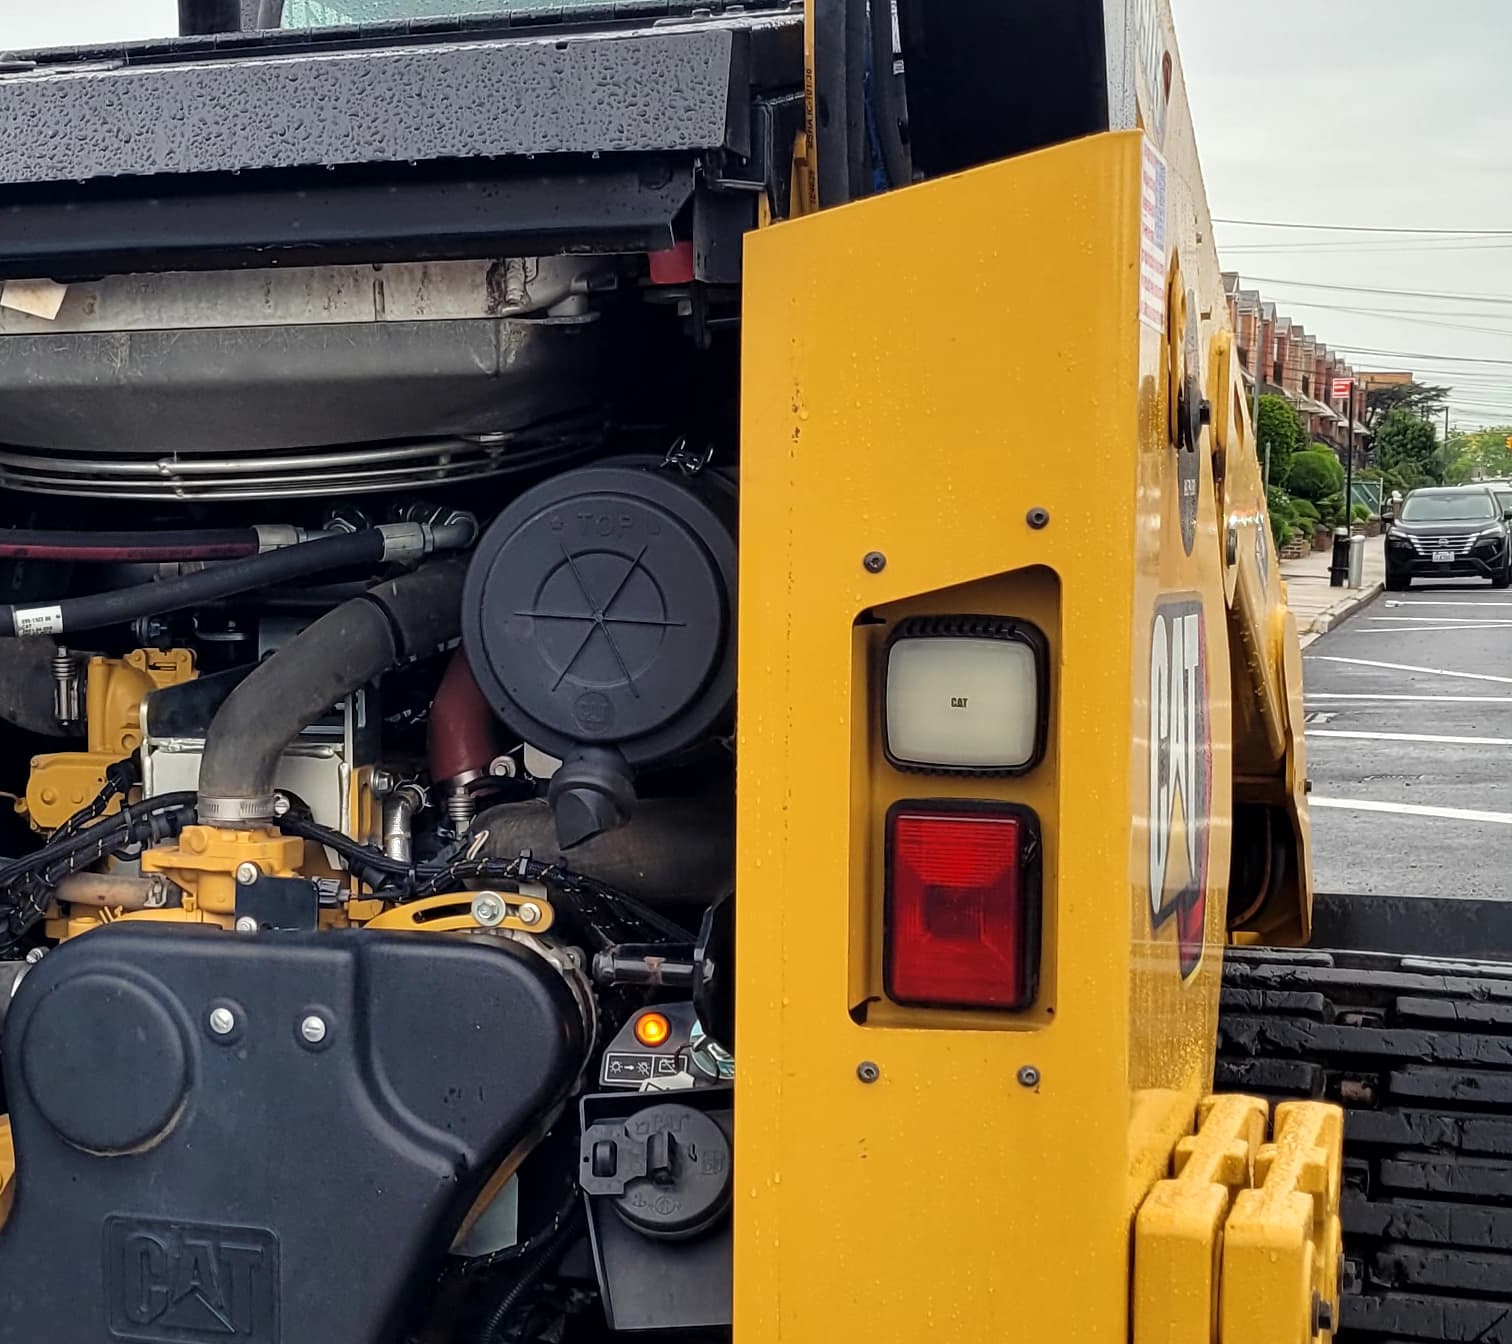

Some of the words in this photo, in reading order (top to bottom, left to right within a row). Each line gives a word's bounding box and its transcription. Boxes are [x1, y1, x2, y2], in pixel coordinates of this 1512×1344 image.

[951, 697, 968, 707] CAT
[1150, 613, 1200, 915] CAT
[123, 1233, 265, 1337] CAT
